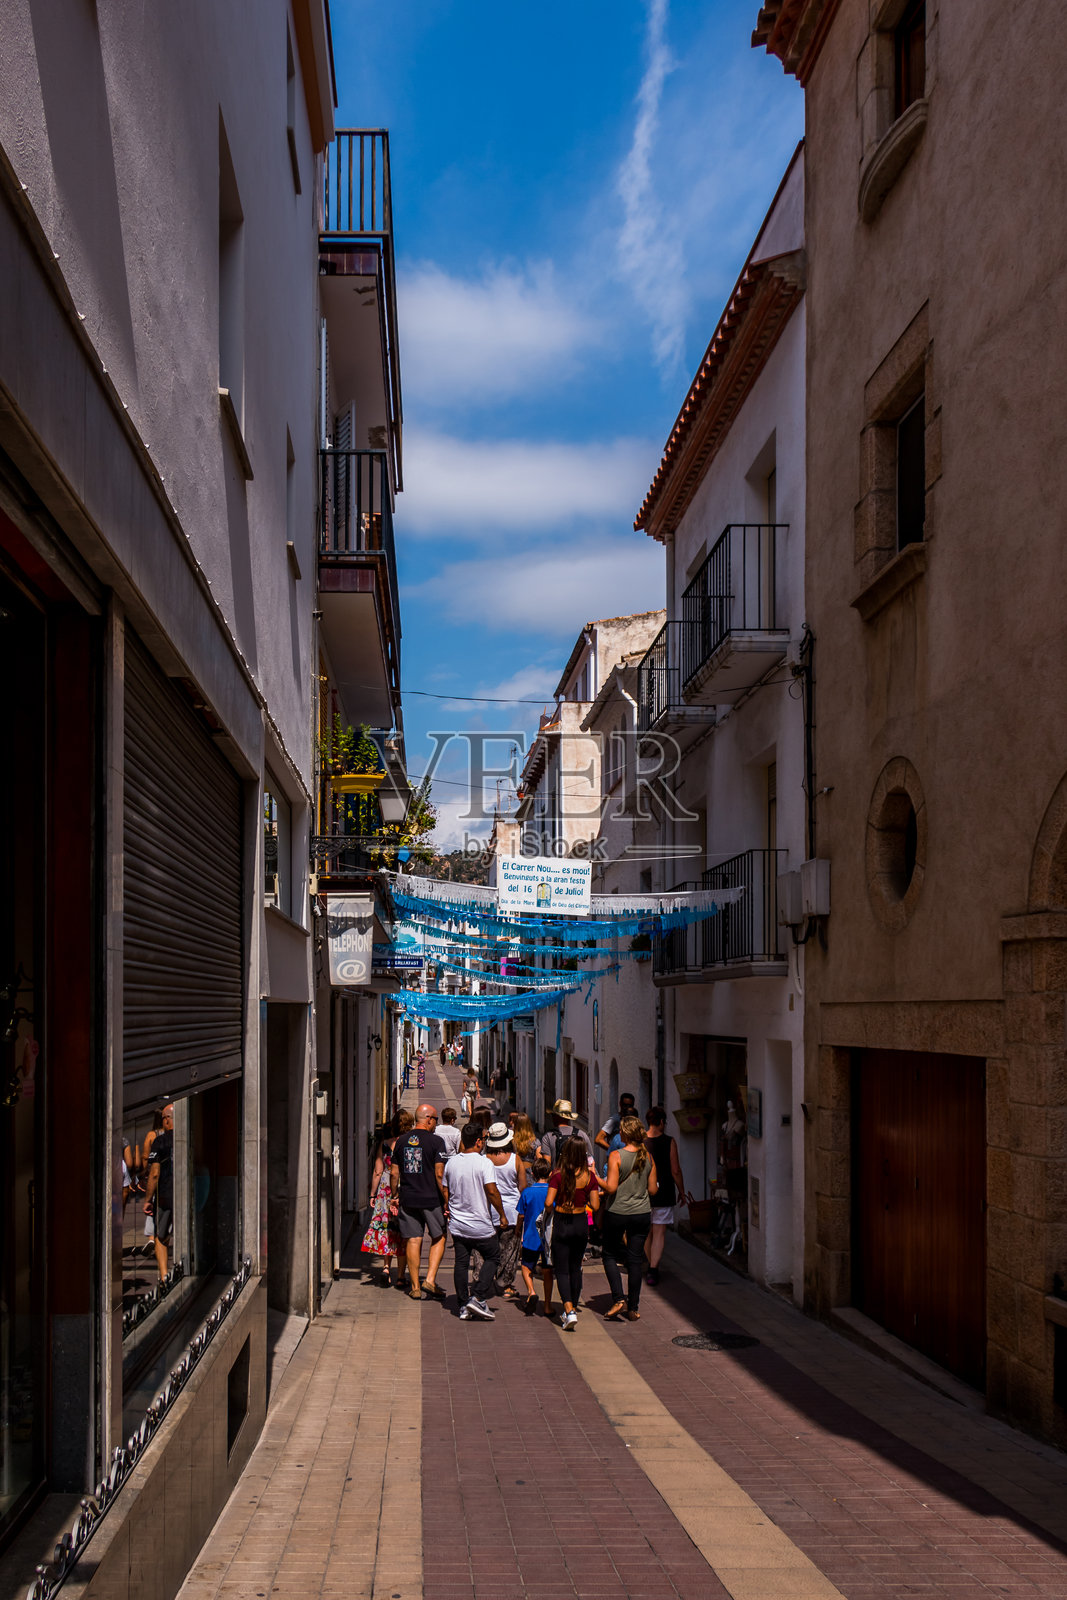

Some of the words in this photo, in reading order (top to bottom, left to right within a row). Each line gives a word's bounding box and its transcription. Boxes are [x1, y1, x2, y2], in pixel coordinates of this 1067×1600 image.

[502, 862, 509, 870] El
[511, 863, 535, 872] Carrer
[572, 867, 590, 875] mou!
[504, 873, 539, 882] Benvinguts
[565, 887, 584, 896] Juliol
